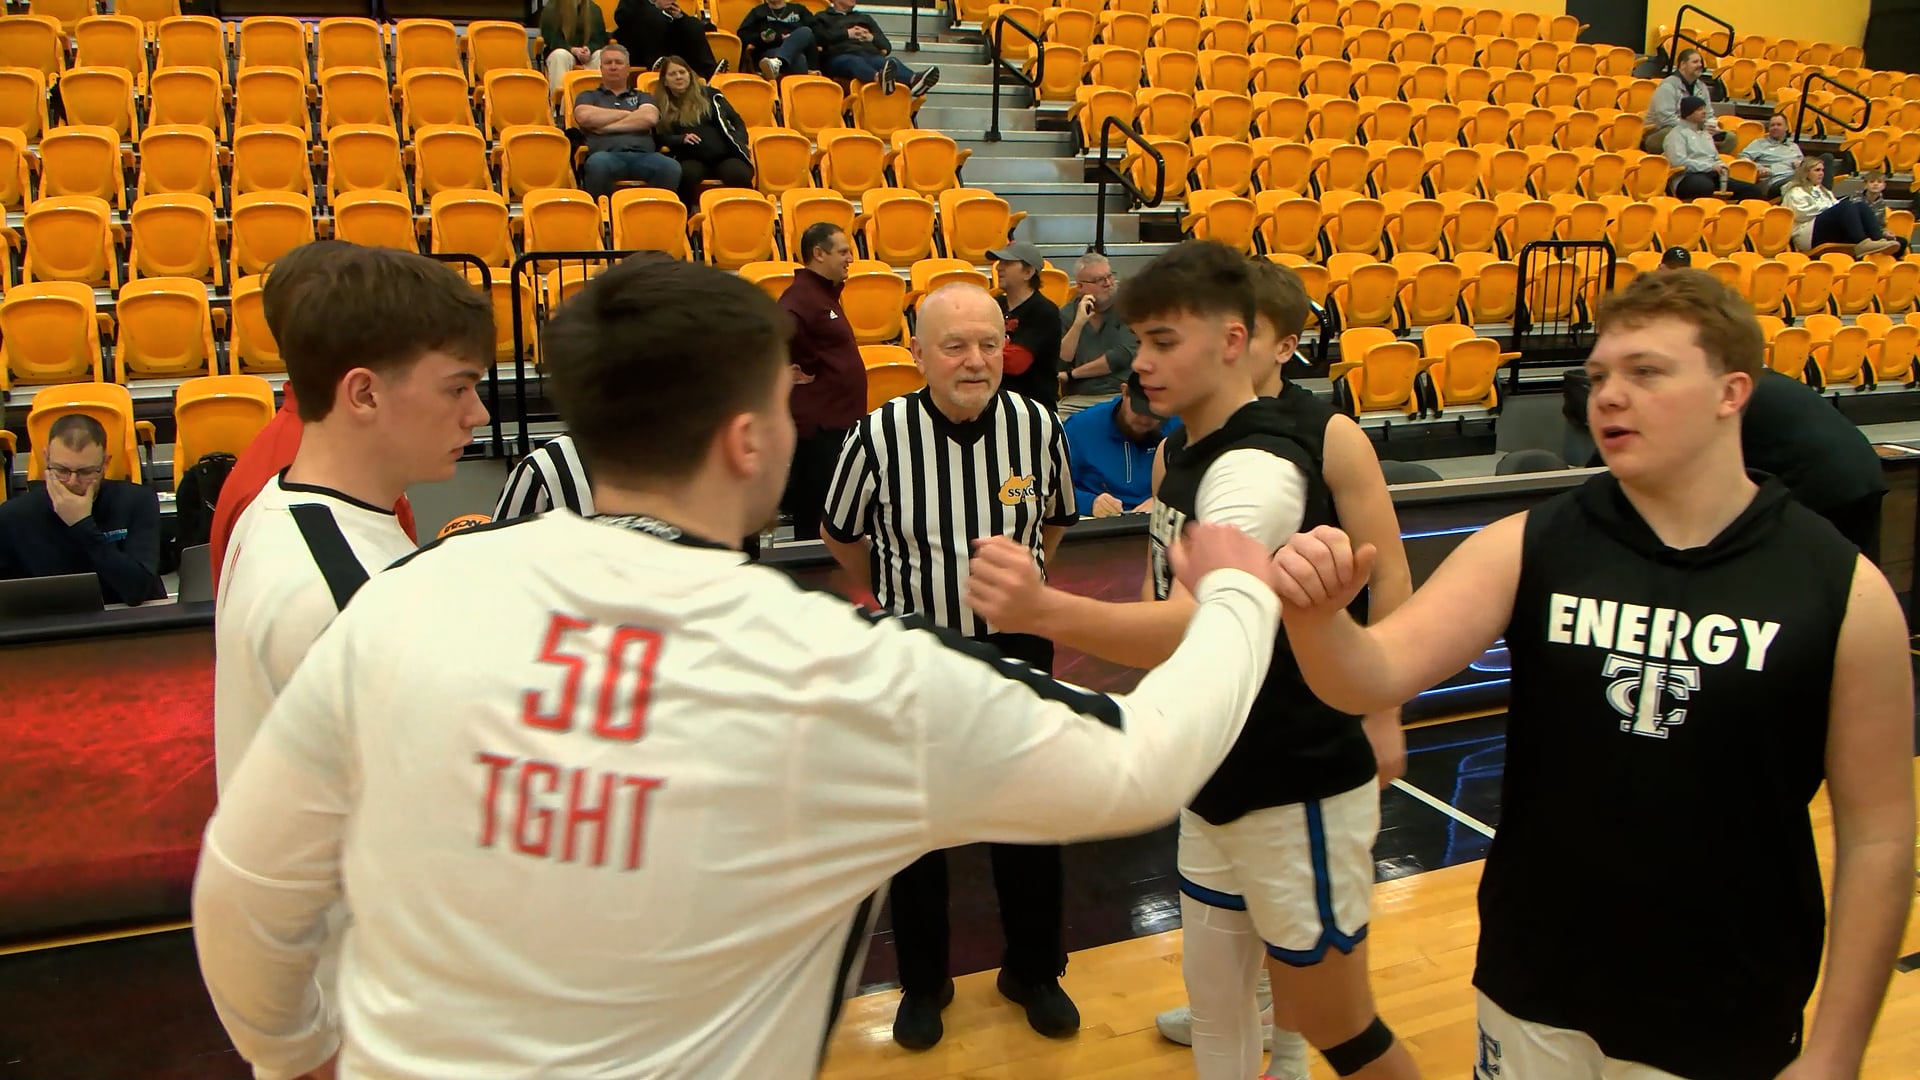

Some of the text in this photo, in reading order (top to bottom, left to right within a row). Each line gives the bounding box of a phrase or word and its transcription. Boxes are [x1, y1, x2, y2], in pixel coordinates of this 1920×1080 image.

[519, 609, 668, 744] 50
[1548, 592, 1781, 672] ENERGY
[473, 751, 669, 871] TGHT
